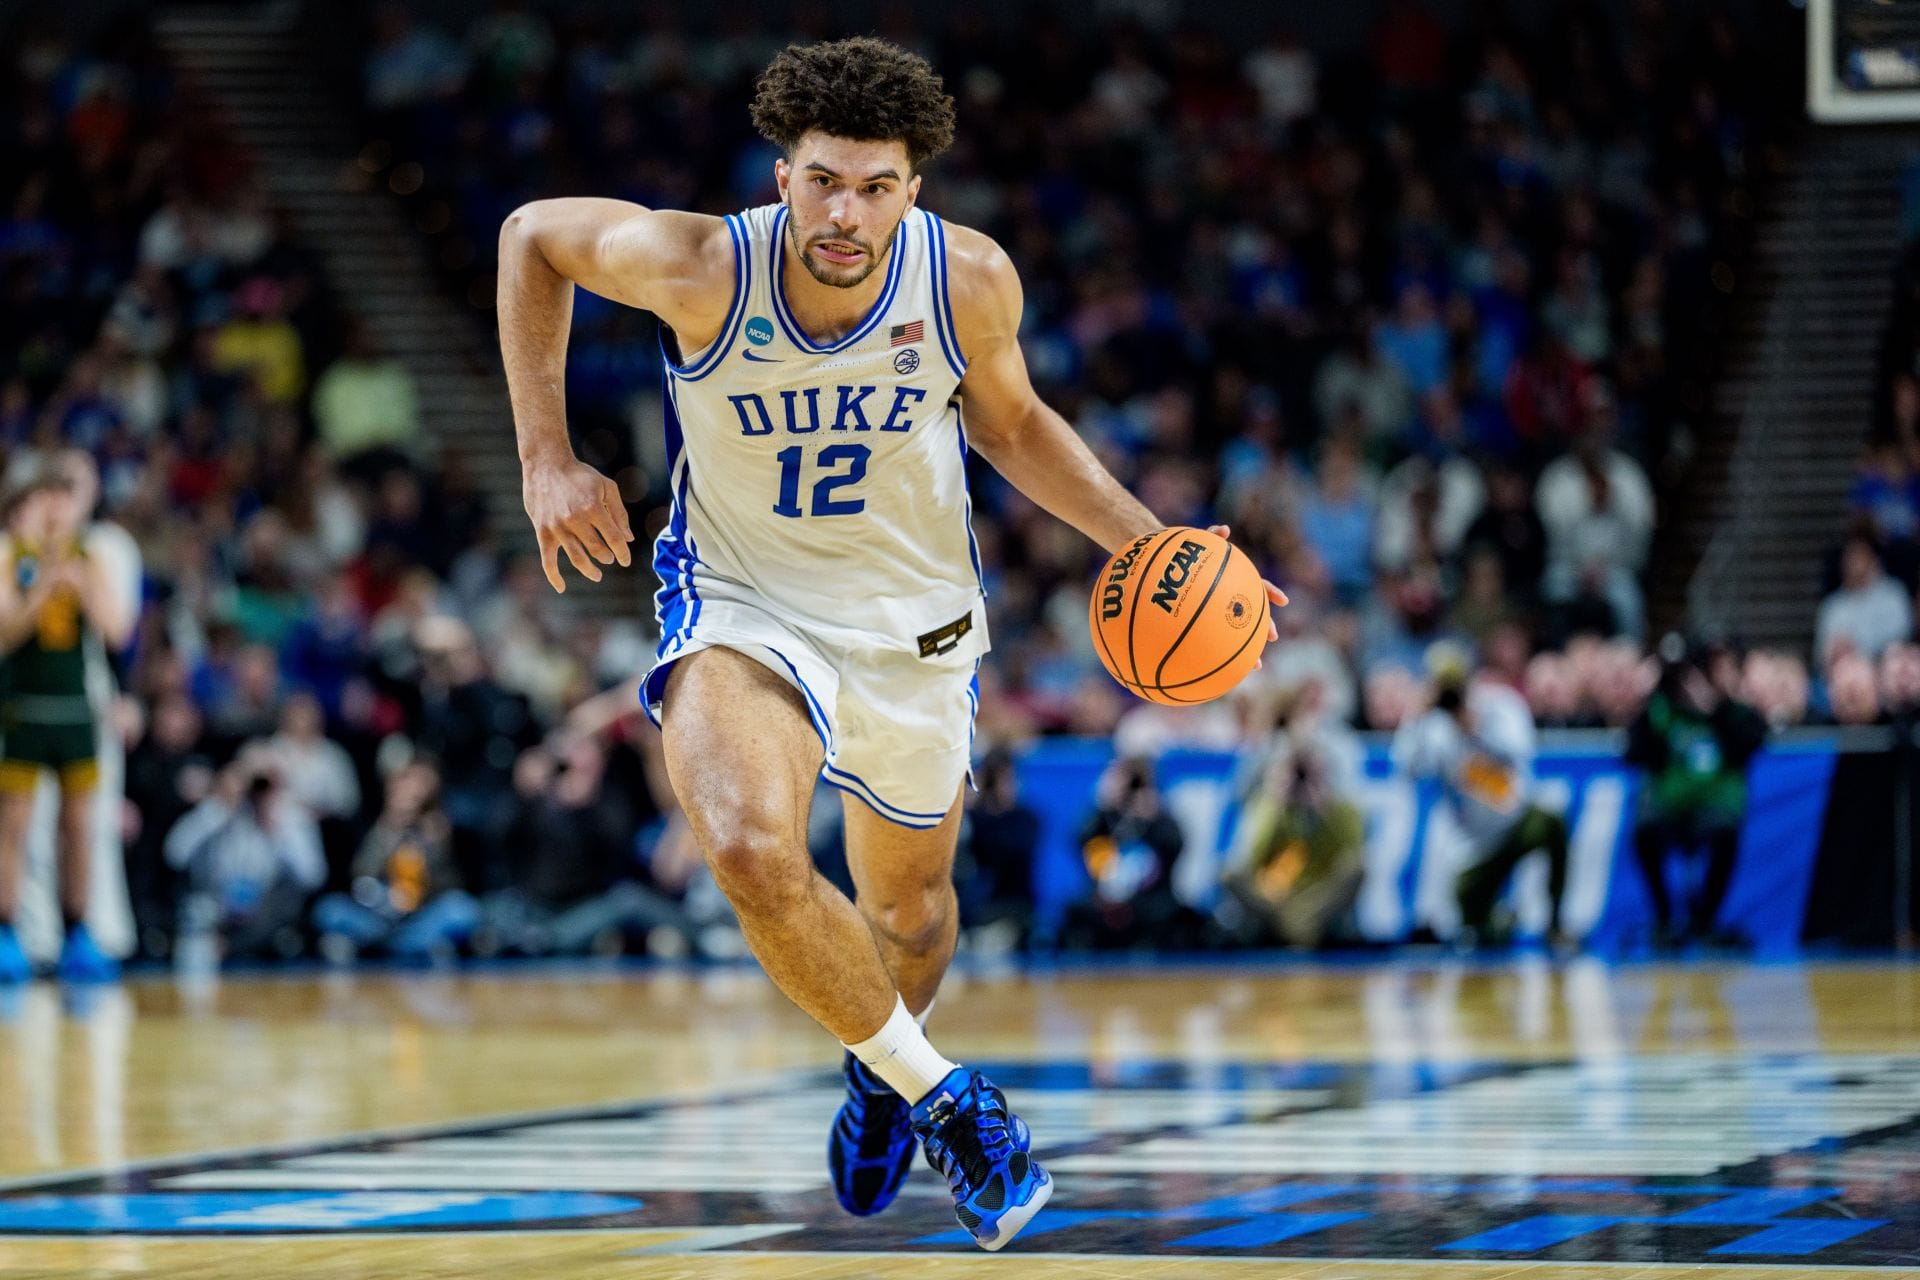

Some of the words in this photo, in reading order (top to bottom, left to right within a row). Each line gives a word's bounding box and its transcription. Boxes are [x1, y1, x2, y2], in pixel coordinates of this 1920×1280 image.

[748, 327, 771, 342] NCAA
[727, 385, 927, 436] DUKE
[773, 443, 872, 518] 12
[1151, 541, 1207, 613] NCAA
[1174, 585, 1192, 618] OFFICIAL
